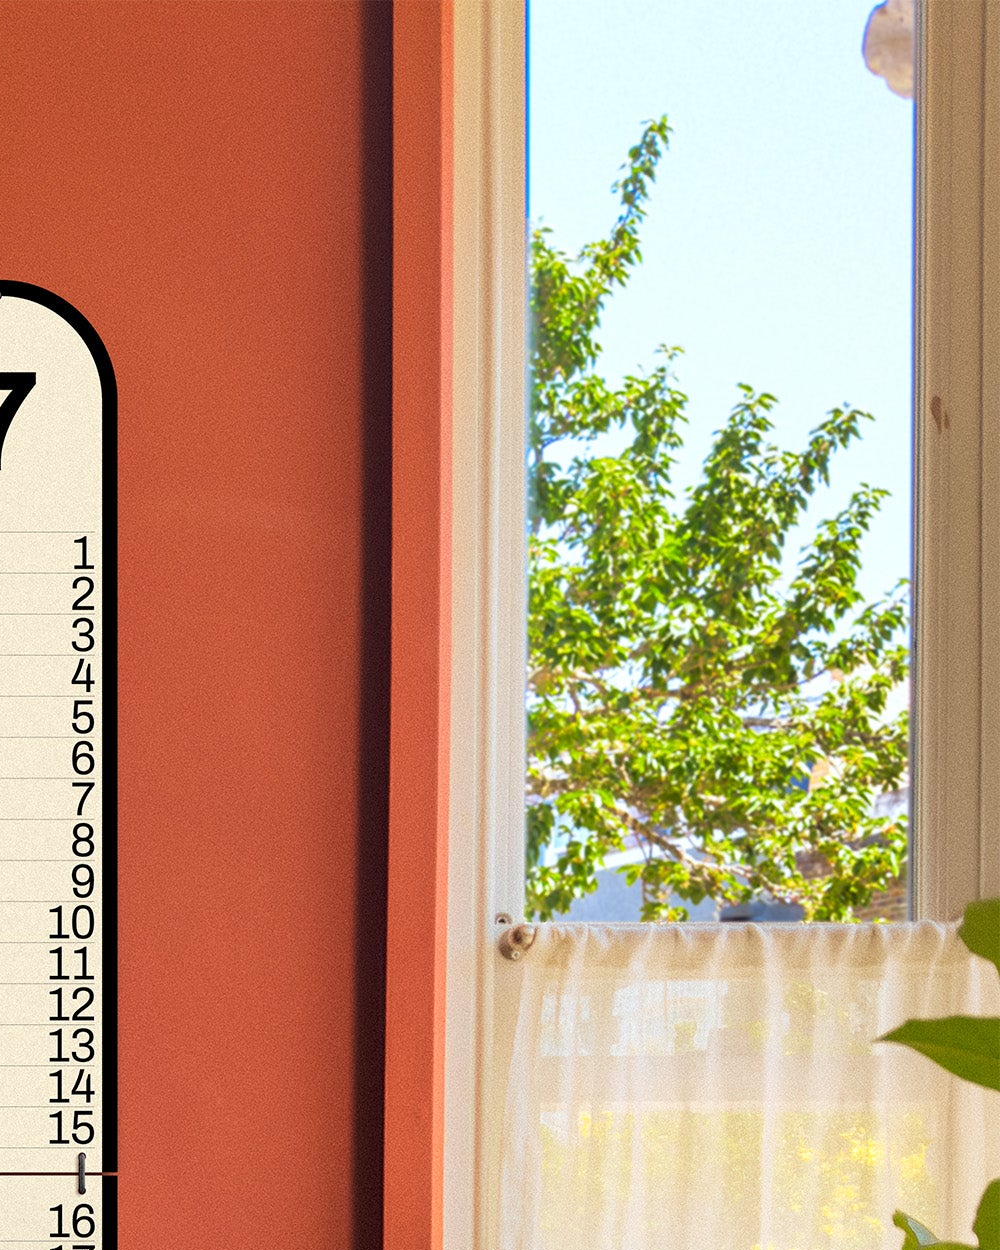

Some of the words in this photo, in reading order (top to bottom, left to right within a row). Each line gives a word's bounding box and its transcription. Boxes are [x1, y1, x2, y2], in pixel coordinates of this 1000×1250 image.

[74, 536, 94, 569] 1
[72, 577, 94, 610] 2
[72, 618, 94, 651] 3
[72, 659, 94, 692] 4
[72, 701, 94, 734] 5
[72, 741, 94, 775] 6
[72, 783, 94, 815] 7
[72, 823, 94, 857] 8
[72, 864, 94, 898] 9
[50, 905, 94, 939] 10
[50, 947, 94, 979] 11
[50, 987, 94, 1020] 12
[50, 1028, 94, 1062] 13
[50, 1069, 94, 1102] 14
[50, 1111, 94, 1144] 15
[50, 1204, 95, 1237] 16
